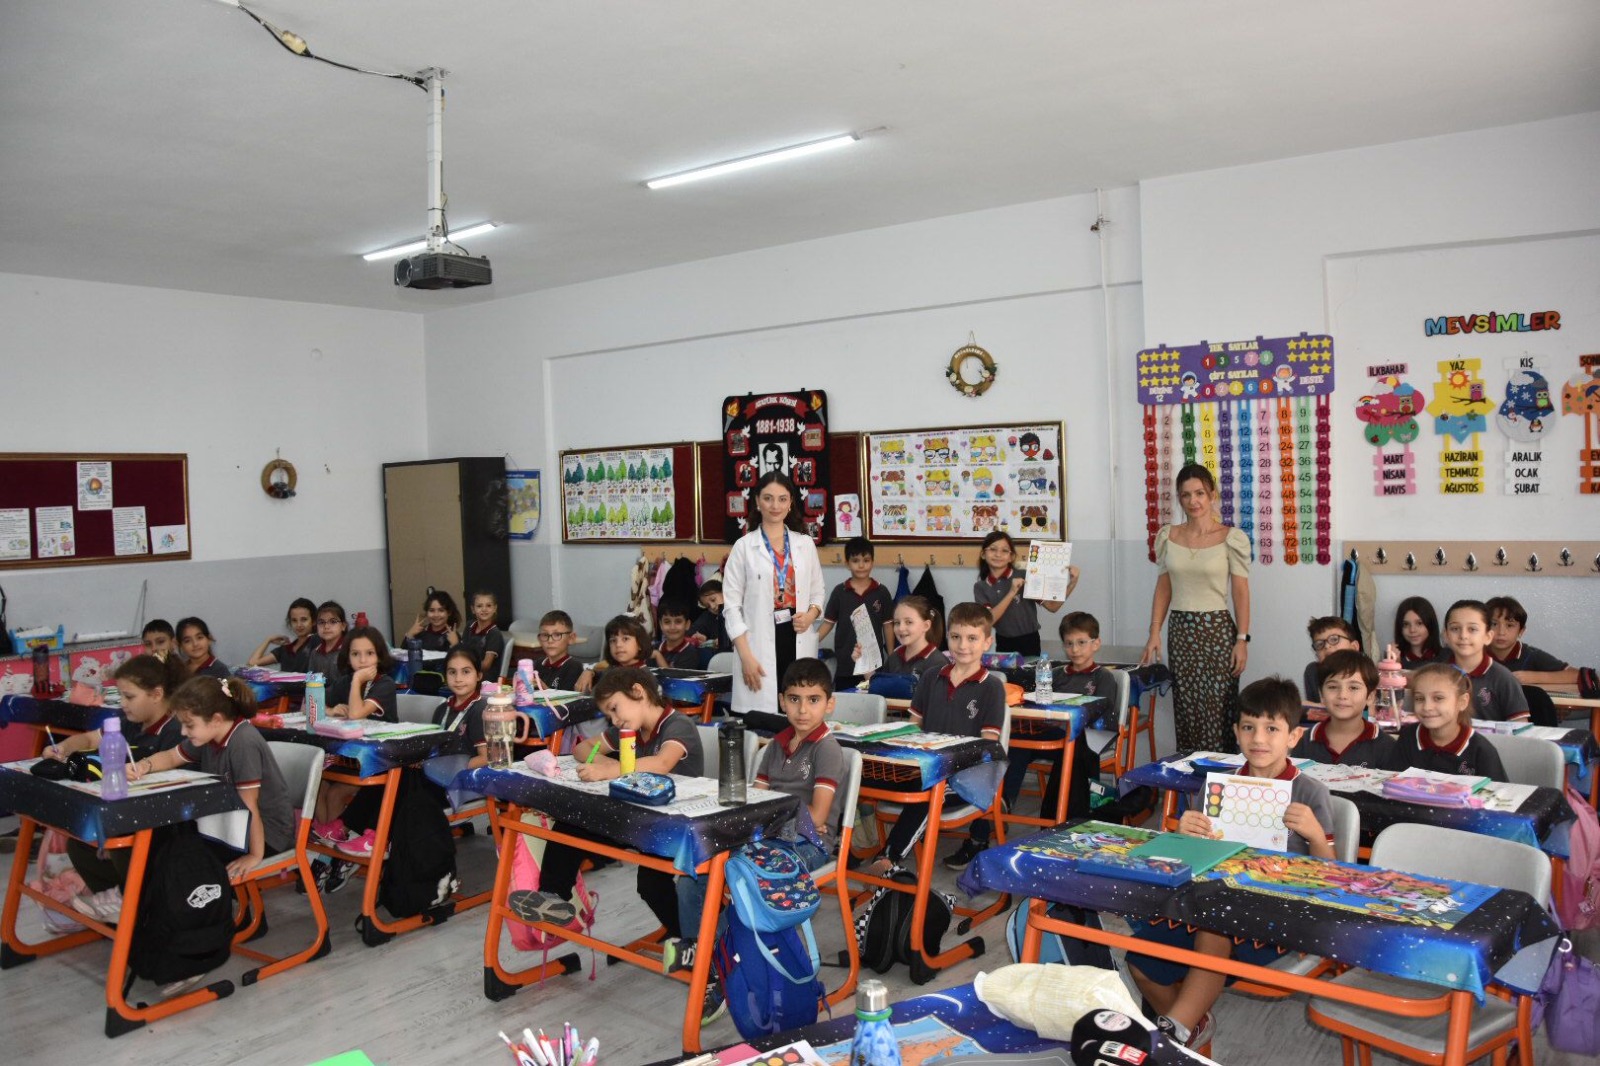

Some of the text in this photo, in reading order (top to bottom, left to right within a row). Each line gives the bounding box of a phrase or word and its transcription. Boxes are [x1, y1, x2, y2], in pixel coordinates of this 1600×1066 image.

[1425, 311, 1561, 337] MEVSİMLER
[1228, 341, 1259, 351] SAYILAR
[1450, 360, 1465, 371] YAZ
[1520, 357, 1533, 369] KIŞ
[1227, 369, 1259, 379] SAYILAR
[1369, 364, 1405, 377] İLKBAHAR
[1307, 385, 1316, 393] 10
[1155, 394, 1164, 402] 12
[1318, 408, 1328, 416] 10
[756, 418, 795, 434] 1881-1938
[1280, 426, 1290, 434] 16
[1300, 425, 1309, 433] 18
[1318, 425, 1329, 433] 20
[1221, 430, 1230, 438] 10
[1240, 427, 1249, 435] 12
[1203, 445, 1213, 453] 12
[1221, 444, 1230, 452] 15
[1259, 443, 1269, 451] 21
[1281, 442, 1292, 450] 24
[1299, 441, 1309, 449] 27
[1383, 454, 1404, 464] MART
[1444, 450, 1478, 462] HAZİRAN
[1512, 452, 1542, 462] ARALIK
[1205, 461, 1214, 469] 16
[1222, 459, 1232, 467] 20
[1241, 459, 1251, 467] 24
[1260, 459, 1271, 467] 28
[1280, 458, 1292, 466] 32
[1299, 457, 1310, 465] 36
[1318, 457, 1330, 465] 40
[1299, 473, 1311, 481] 45
[1382, 468, 1406, 479] NİSAN
[1445, 468, 1479, 478] TEMMUZ
[1515, 468, 1538, 478] OCAK
[1162, 477, 1171, 485] 10
[1222, 475, 1232, 483] 25
[1241, 475, 1251, 483] 30
[1260, 475, 1271, 483] 35
[1281, 475, 1294, 483] 40
[1383, 484, 1406, 494] MAYIS
[1444, 482, 1479, 493] AĞUSTOS
[1514, 484, 1540, 495] ŞUBAT
[1161, 492, 1171, 500] 12
[1259, 491, 1270, 499] 42
[1282, 489, 1294, 498] 48
[1300, 489, 1311, 497] 54
[1240, 506, 1252, 514] 42
[1260, 506, 1271, 514] 49
[1283, 506, 1295, 514] 56
[1300, 506, 1312, 514] 63
[1318, 506, 1330, 514] 70
[1260, 522, 1272, 531] 56
[1283, 523, 1296, 531] 64
[1301, 522, 1312, 530] 72
[1260, 539, 1272, 547] 63
[1285, 538, 1296, 546] 72
[1301, 538, 1312, 546] 81
[1261, 554, 1272, 563] 70
[1285, 554, 1297, 563] 80
[1301, 554, 1313, 562] 90
